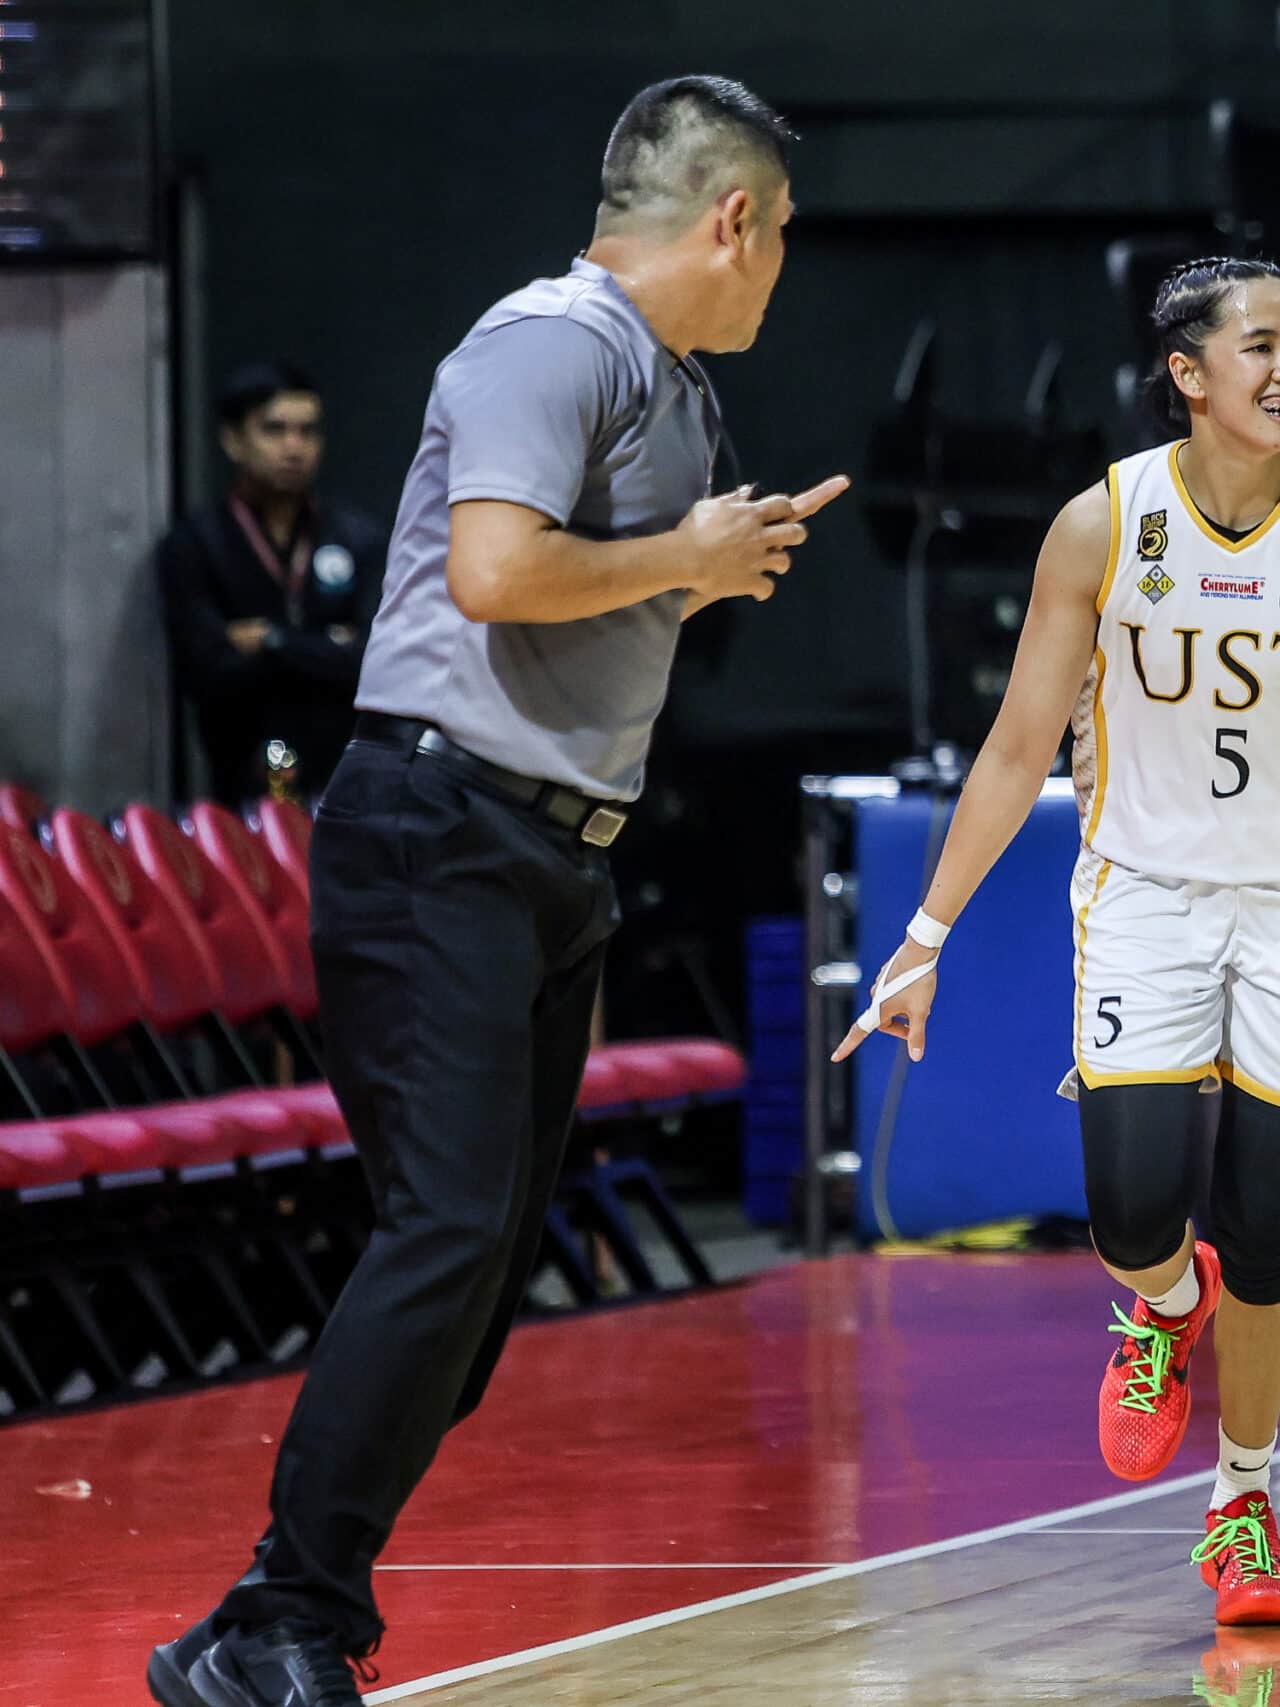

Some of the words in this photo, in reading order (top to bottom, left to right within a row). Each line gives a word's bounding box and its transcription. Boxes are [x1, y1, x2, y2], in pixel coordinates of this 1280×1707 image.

[1142, 580, 1151, 589] 16
[1161, 580, 1169, 589] 11
[1200, 577, 1259, 594] CHERRYLUME
[1211, 728, 1250, 799] 5
[1093, 995, 1123, 1049] 5
